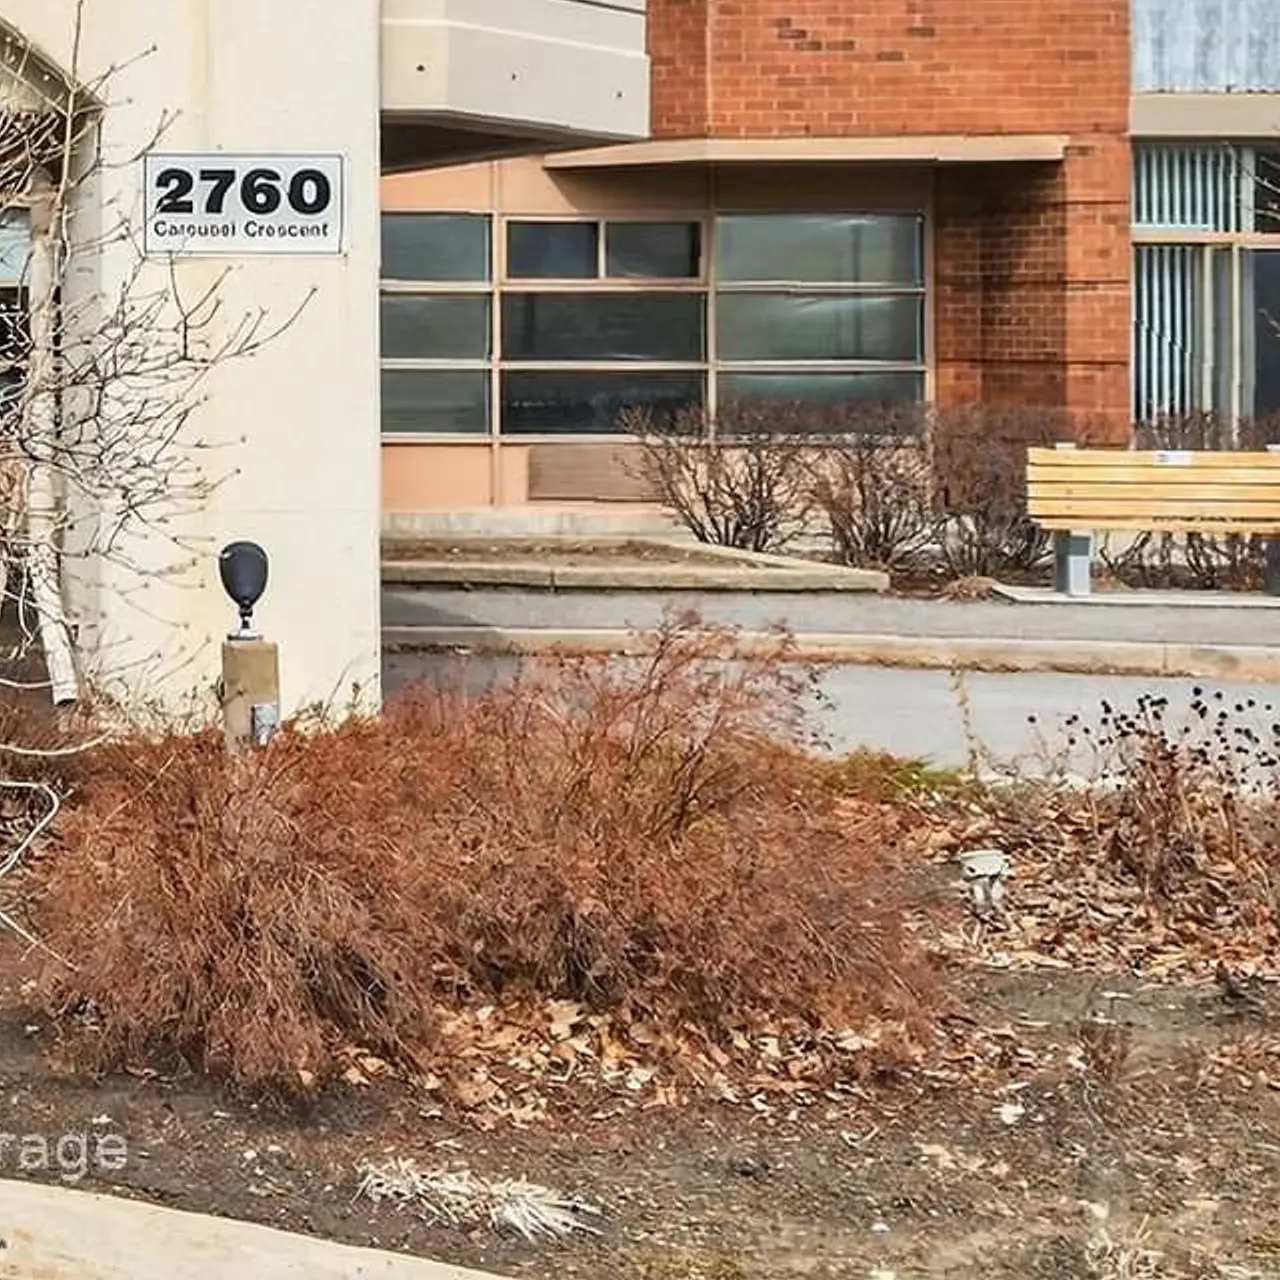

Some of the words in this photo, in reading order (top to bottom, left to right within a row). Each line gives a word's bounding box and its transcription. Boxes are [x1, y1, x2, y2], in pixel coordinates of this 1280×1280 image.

[155, 168, 332, 216] 2760
[153, 220, 236, 237] Carousel
[243, 220, 329, 238] Crescent
